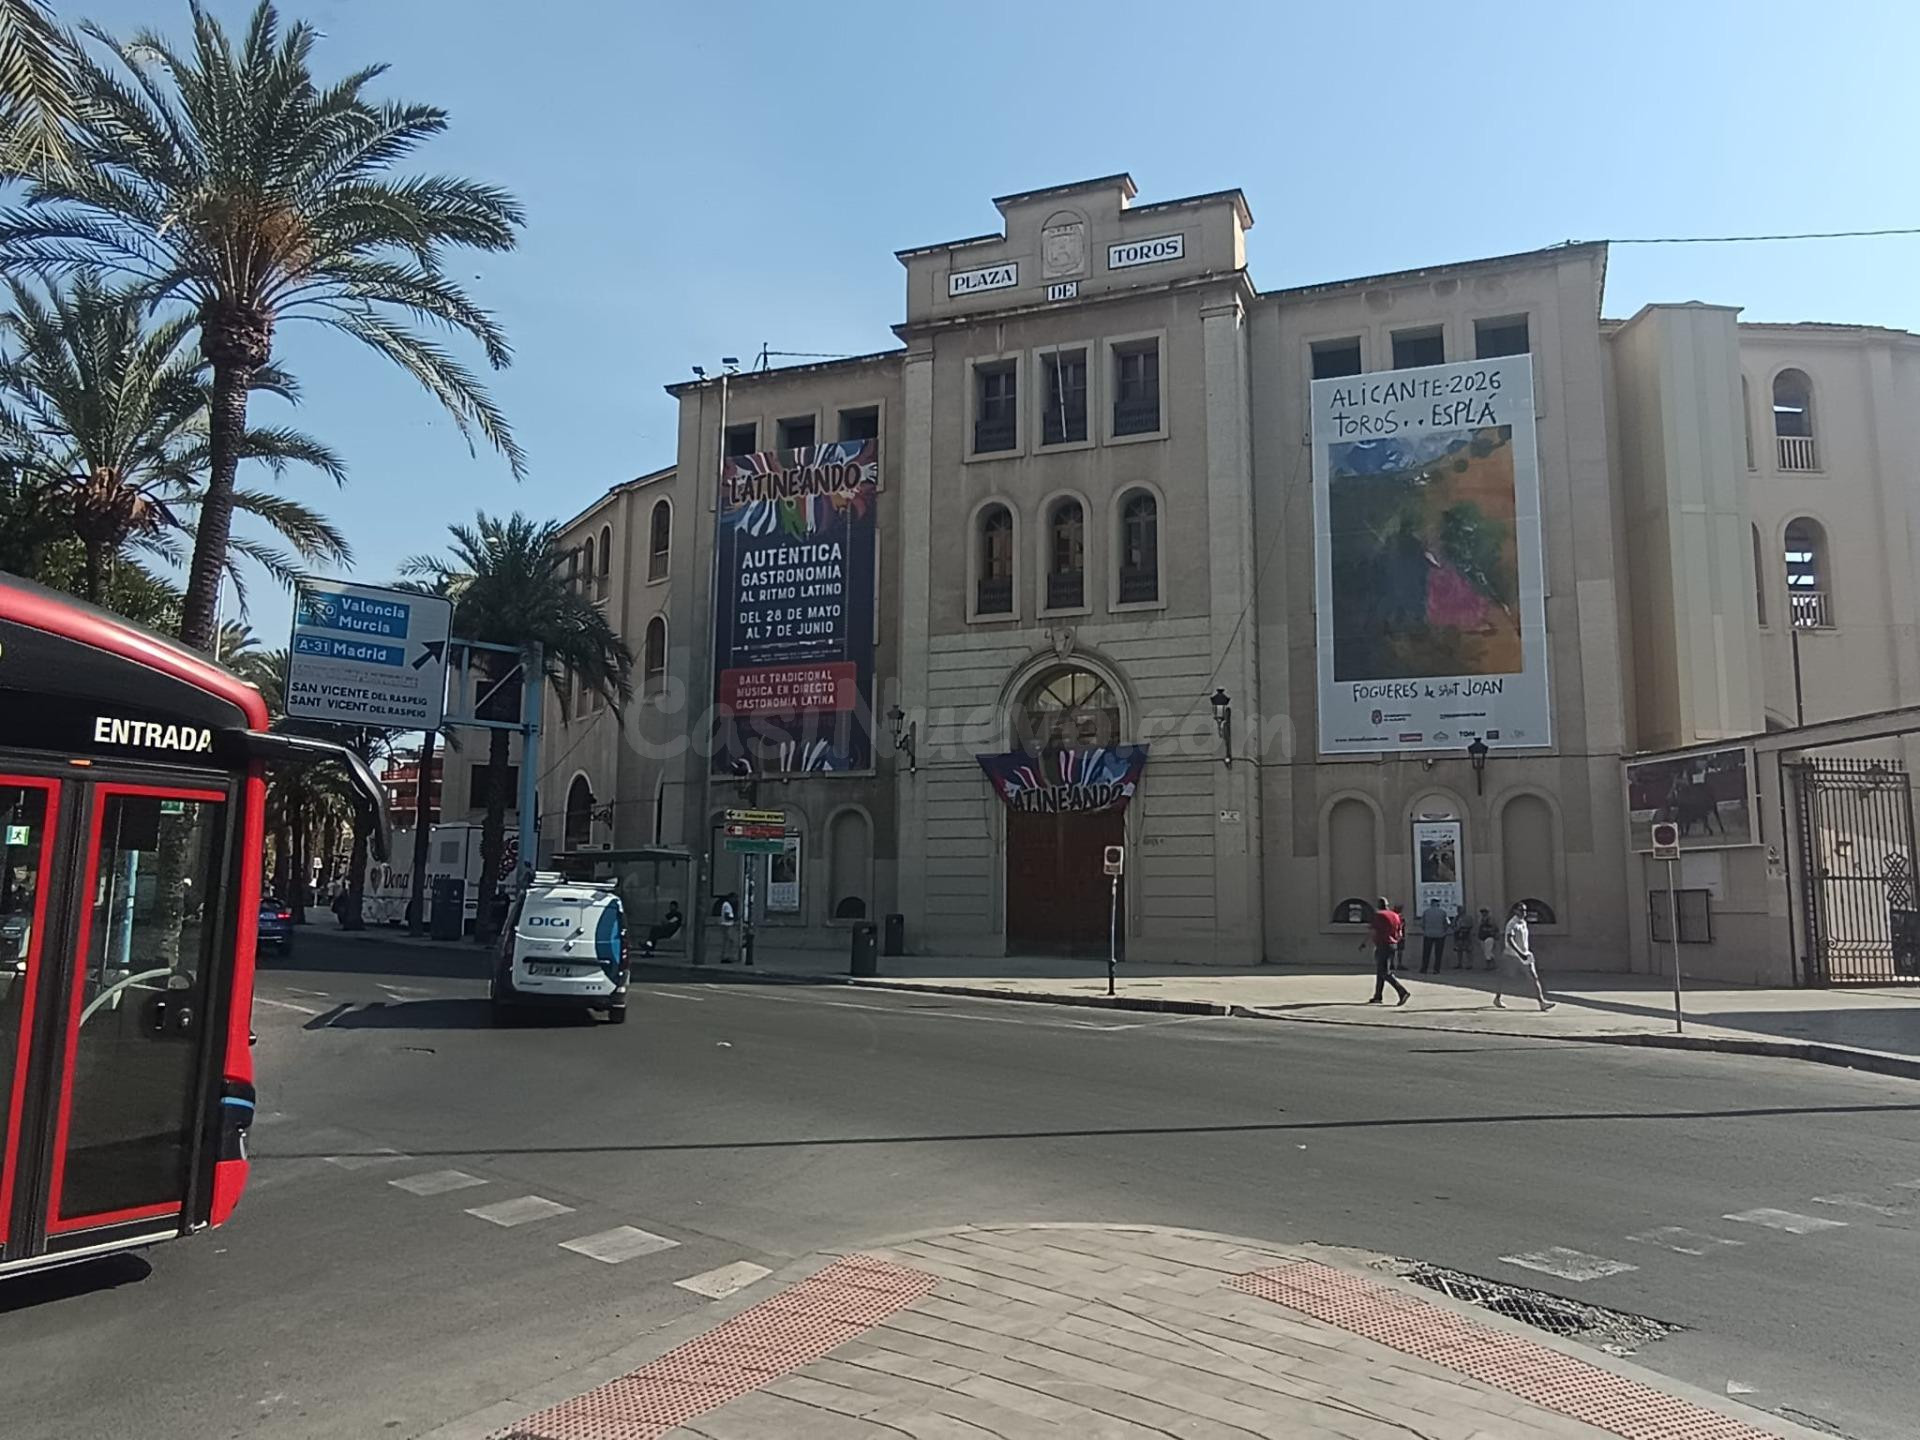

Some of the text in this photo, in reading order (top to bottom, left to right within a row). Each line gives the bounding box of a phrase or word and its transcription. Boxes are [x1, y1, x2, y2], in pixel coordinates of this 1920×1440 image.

[954, 239, 1178, 299] PLAZA DE TOROS
[1432, 392, 1497, 427] ESPLÁ
[729, 462, 863, 505] LATINEANDO
[742, 542, 842, 570] AUTÉNTICA
[741, 561, 842, 587] GASTRONOMÍA
[741, 582, 842, 603] AL RITMO LATINO
[341, 598, 406, 619] Valencia
[740, 604, 841, 624] DEL 28 DE MAYO
[338, 615, 390, 634] Murcia
[746, 620, 834, 639] AL 7 DE JUNIO
[299, 639, 387, 661] A-31 Madrid
[739, 670, 833, 686] BAILE TRADICIONAL
[777, 684, 789, 695] EN
[793, 682, 835, 694] DIRECTO
[291, 682, 428, 706] SAN VICENTE DEL RASPEIG
[801, 694, 835, 706] LATINA
[1353, 682, 1418, 702] FOGUERES
[1463, 678, 1503, 697] JOAN
[290, 695, 427, 718] SANT VICENT DEL RASPEIG
[94, 716, 213, 753] ENTRADA
[1010, 783, 1124, 813] ATINEANDO
[528, 916, 570, 927] DIGI
